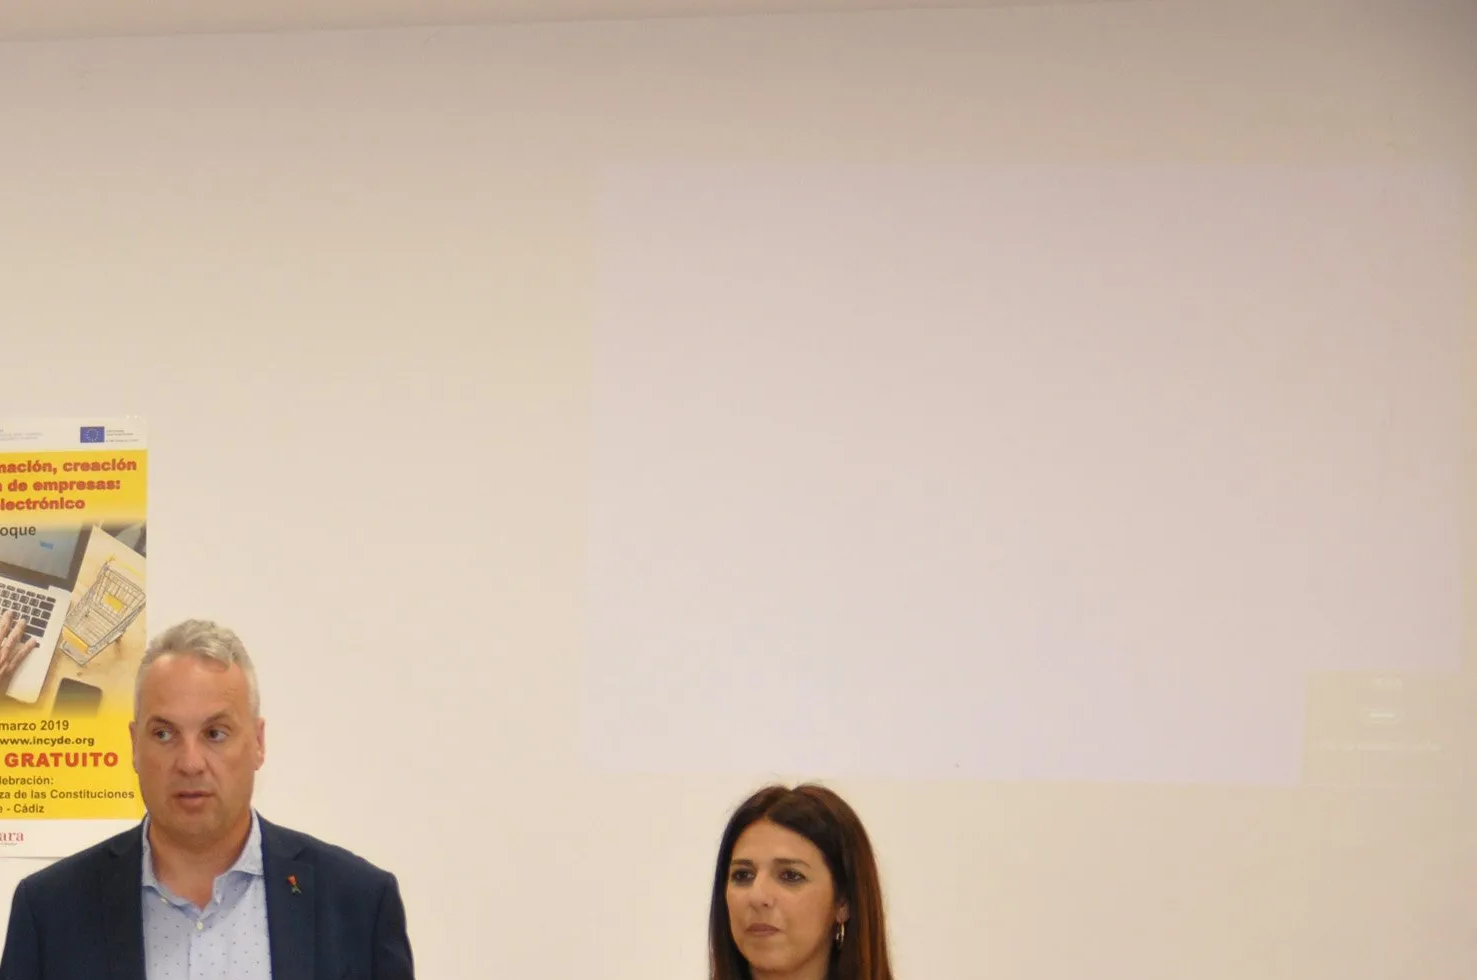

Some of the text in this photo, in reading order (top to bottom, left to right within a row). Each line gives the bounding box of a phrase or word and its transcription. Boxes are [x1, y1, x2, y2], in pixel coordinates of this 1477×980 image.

[63, 458, 136, 471] creación
[8, 480, 27, 492] de
[33, 480, 121, 493] empresas:
[40, 721, 69, 731] 2019
[0, 737, 95, 747] www.incyde.org
[4, 753, 118, 767] GRATUITO
[15, 790, 28, 799] de
[31, 790, 46, 799] las
[50, 789, 135, 798] Constituciones
[14, 803, 45, 813] Cádiz
